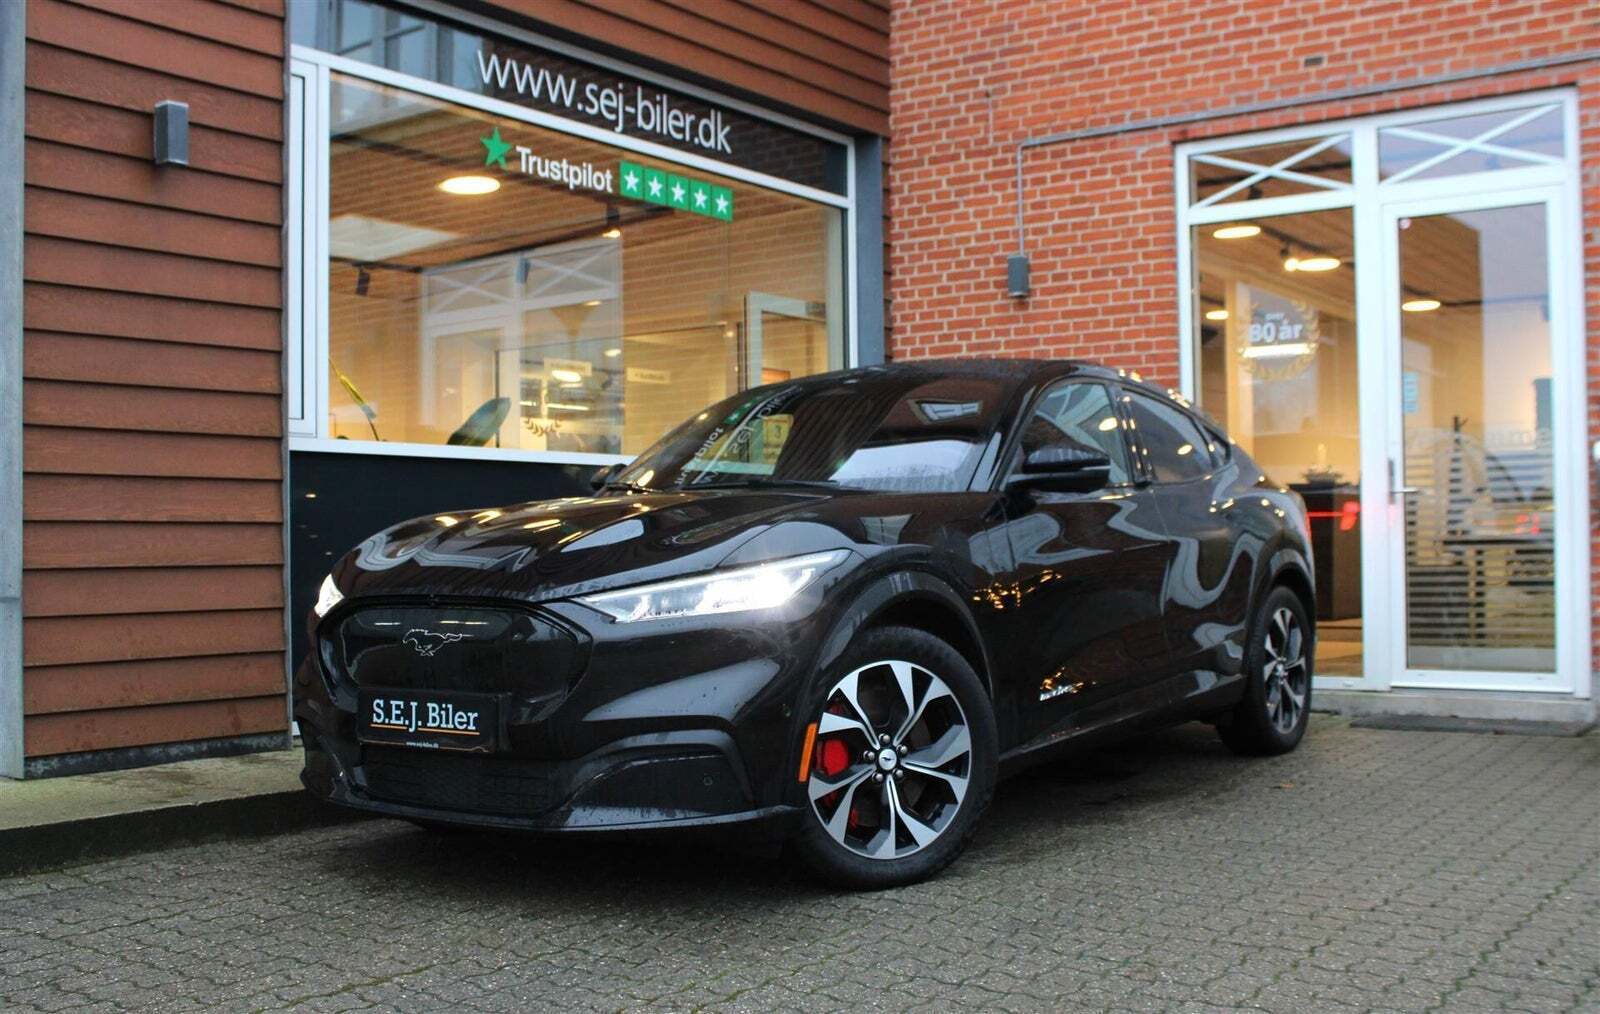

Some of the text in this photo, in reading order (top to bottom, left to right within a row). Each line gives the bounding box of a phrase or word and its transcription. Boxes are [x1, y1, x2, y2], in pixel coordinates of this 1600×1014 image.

[477, 49, 732, 155] www.sej-biler.dk
[515, 145, 613, 194] Trustpilot
[372, 698, 479, 733] S.E.J. Biler
